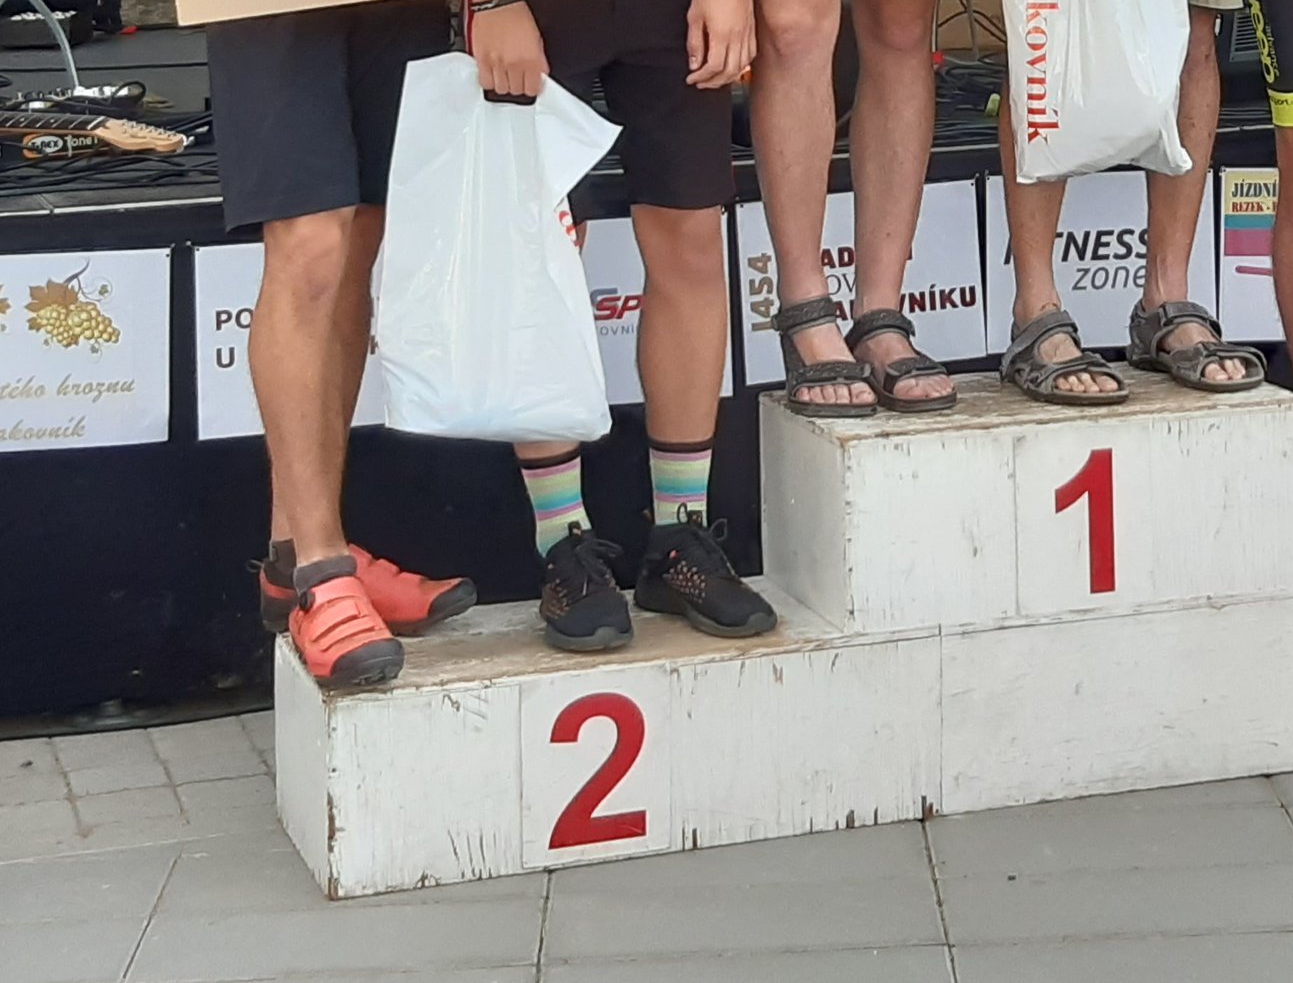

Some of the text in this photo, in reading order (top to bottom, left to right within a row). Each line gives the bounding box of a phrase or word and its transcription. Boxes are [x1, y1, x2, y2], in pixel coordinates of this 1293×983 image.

[747, 252, 775, 332] 1454
[1072, 266, 1146, 290] zone
[216, 346, 235, 368] U
[56, 373, 136, 403] hroznu
[1054, 449, 1115, 593] 1
[547, 692, 648, 849] 2
